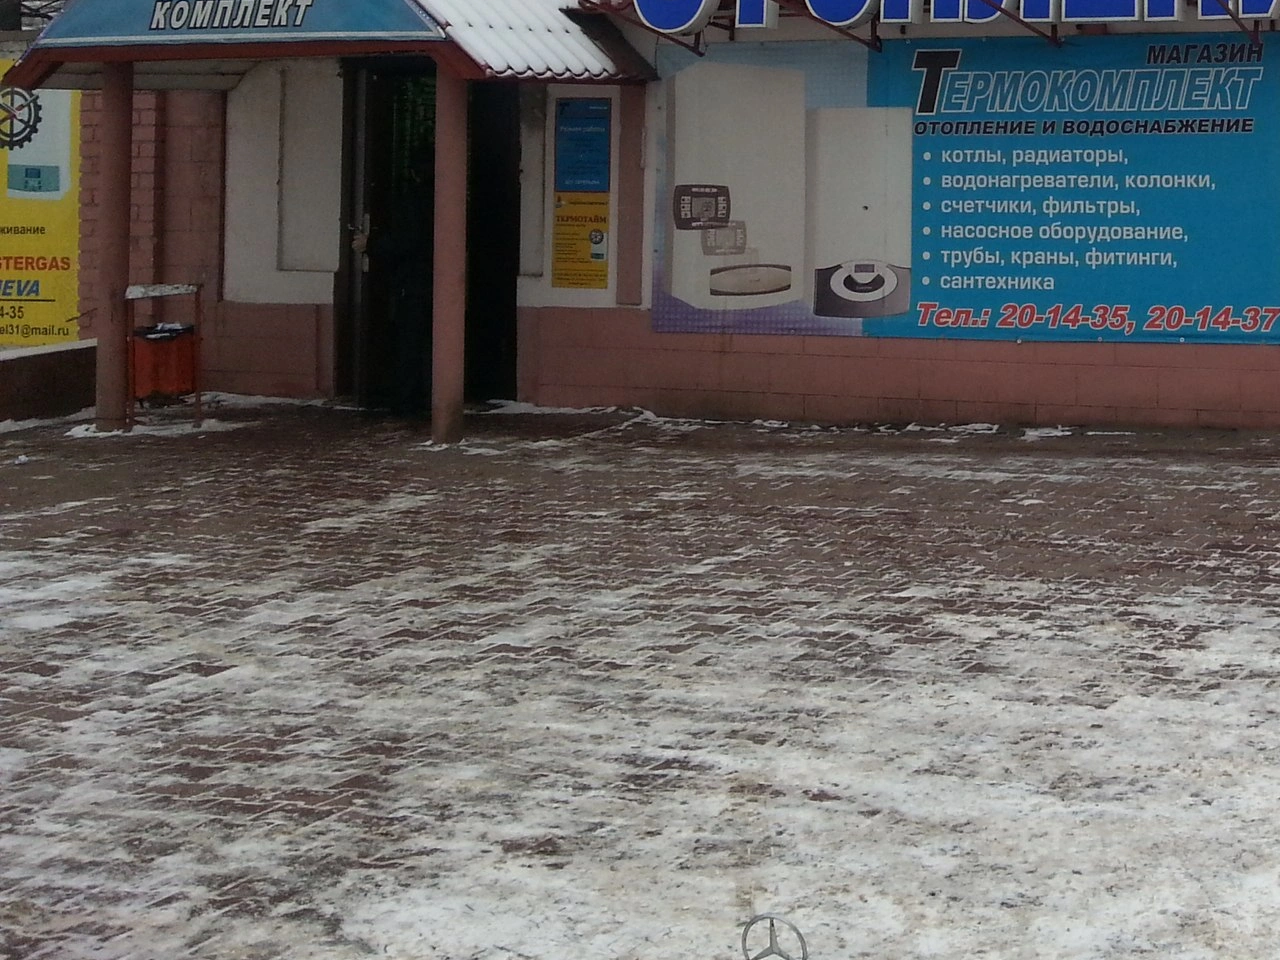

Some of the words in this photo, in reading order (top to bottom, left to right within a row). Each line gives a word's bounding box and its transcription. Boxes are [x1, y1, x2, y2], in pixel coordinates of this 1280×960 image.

[1146, 43, 1264, 65] МАГАЗИН
[912, 48, 1264, 115] ТЕРМОКОМПЛЕКТ
[914, 120, 1036, 135] ОТОПЛЕНИЕ
[1042, 120, 1056, 134] И
[1063, 118, 1254, 136] ВОДОСНАБЖЕНИЕ
[941, 149, 1006, 165] котлы,
[1012, 149, 1128, 166] радиаторы,
[941, 173, 1119, 191] водонагреватели,
[1125, 174, 1216, 191] колонки,
[941, 200, 1036, 215] счетчики,
[1042, 198, 1140, 217] фильтры,
[941, 225, 1033, 239] насосное
[1039, 223, 1188, 242] оборудование,
[0, 256, 71, 270] TERGAS
[940, 249, 1005, 267] трубы,
[1011, 251, 1079, 268] краны,
[1085, 249, 1177, 268] фитинги,
[0, 279, 40, 297] EVA
[940, 275, 1055, 290] сантехника
[917, 302, 990, 327] Тел.:
[996, 303, 1135, 334] 20-14-35,
